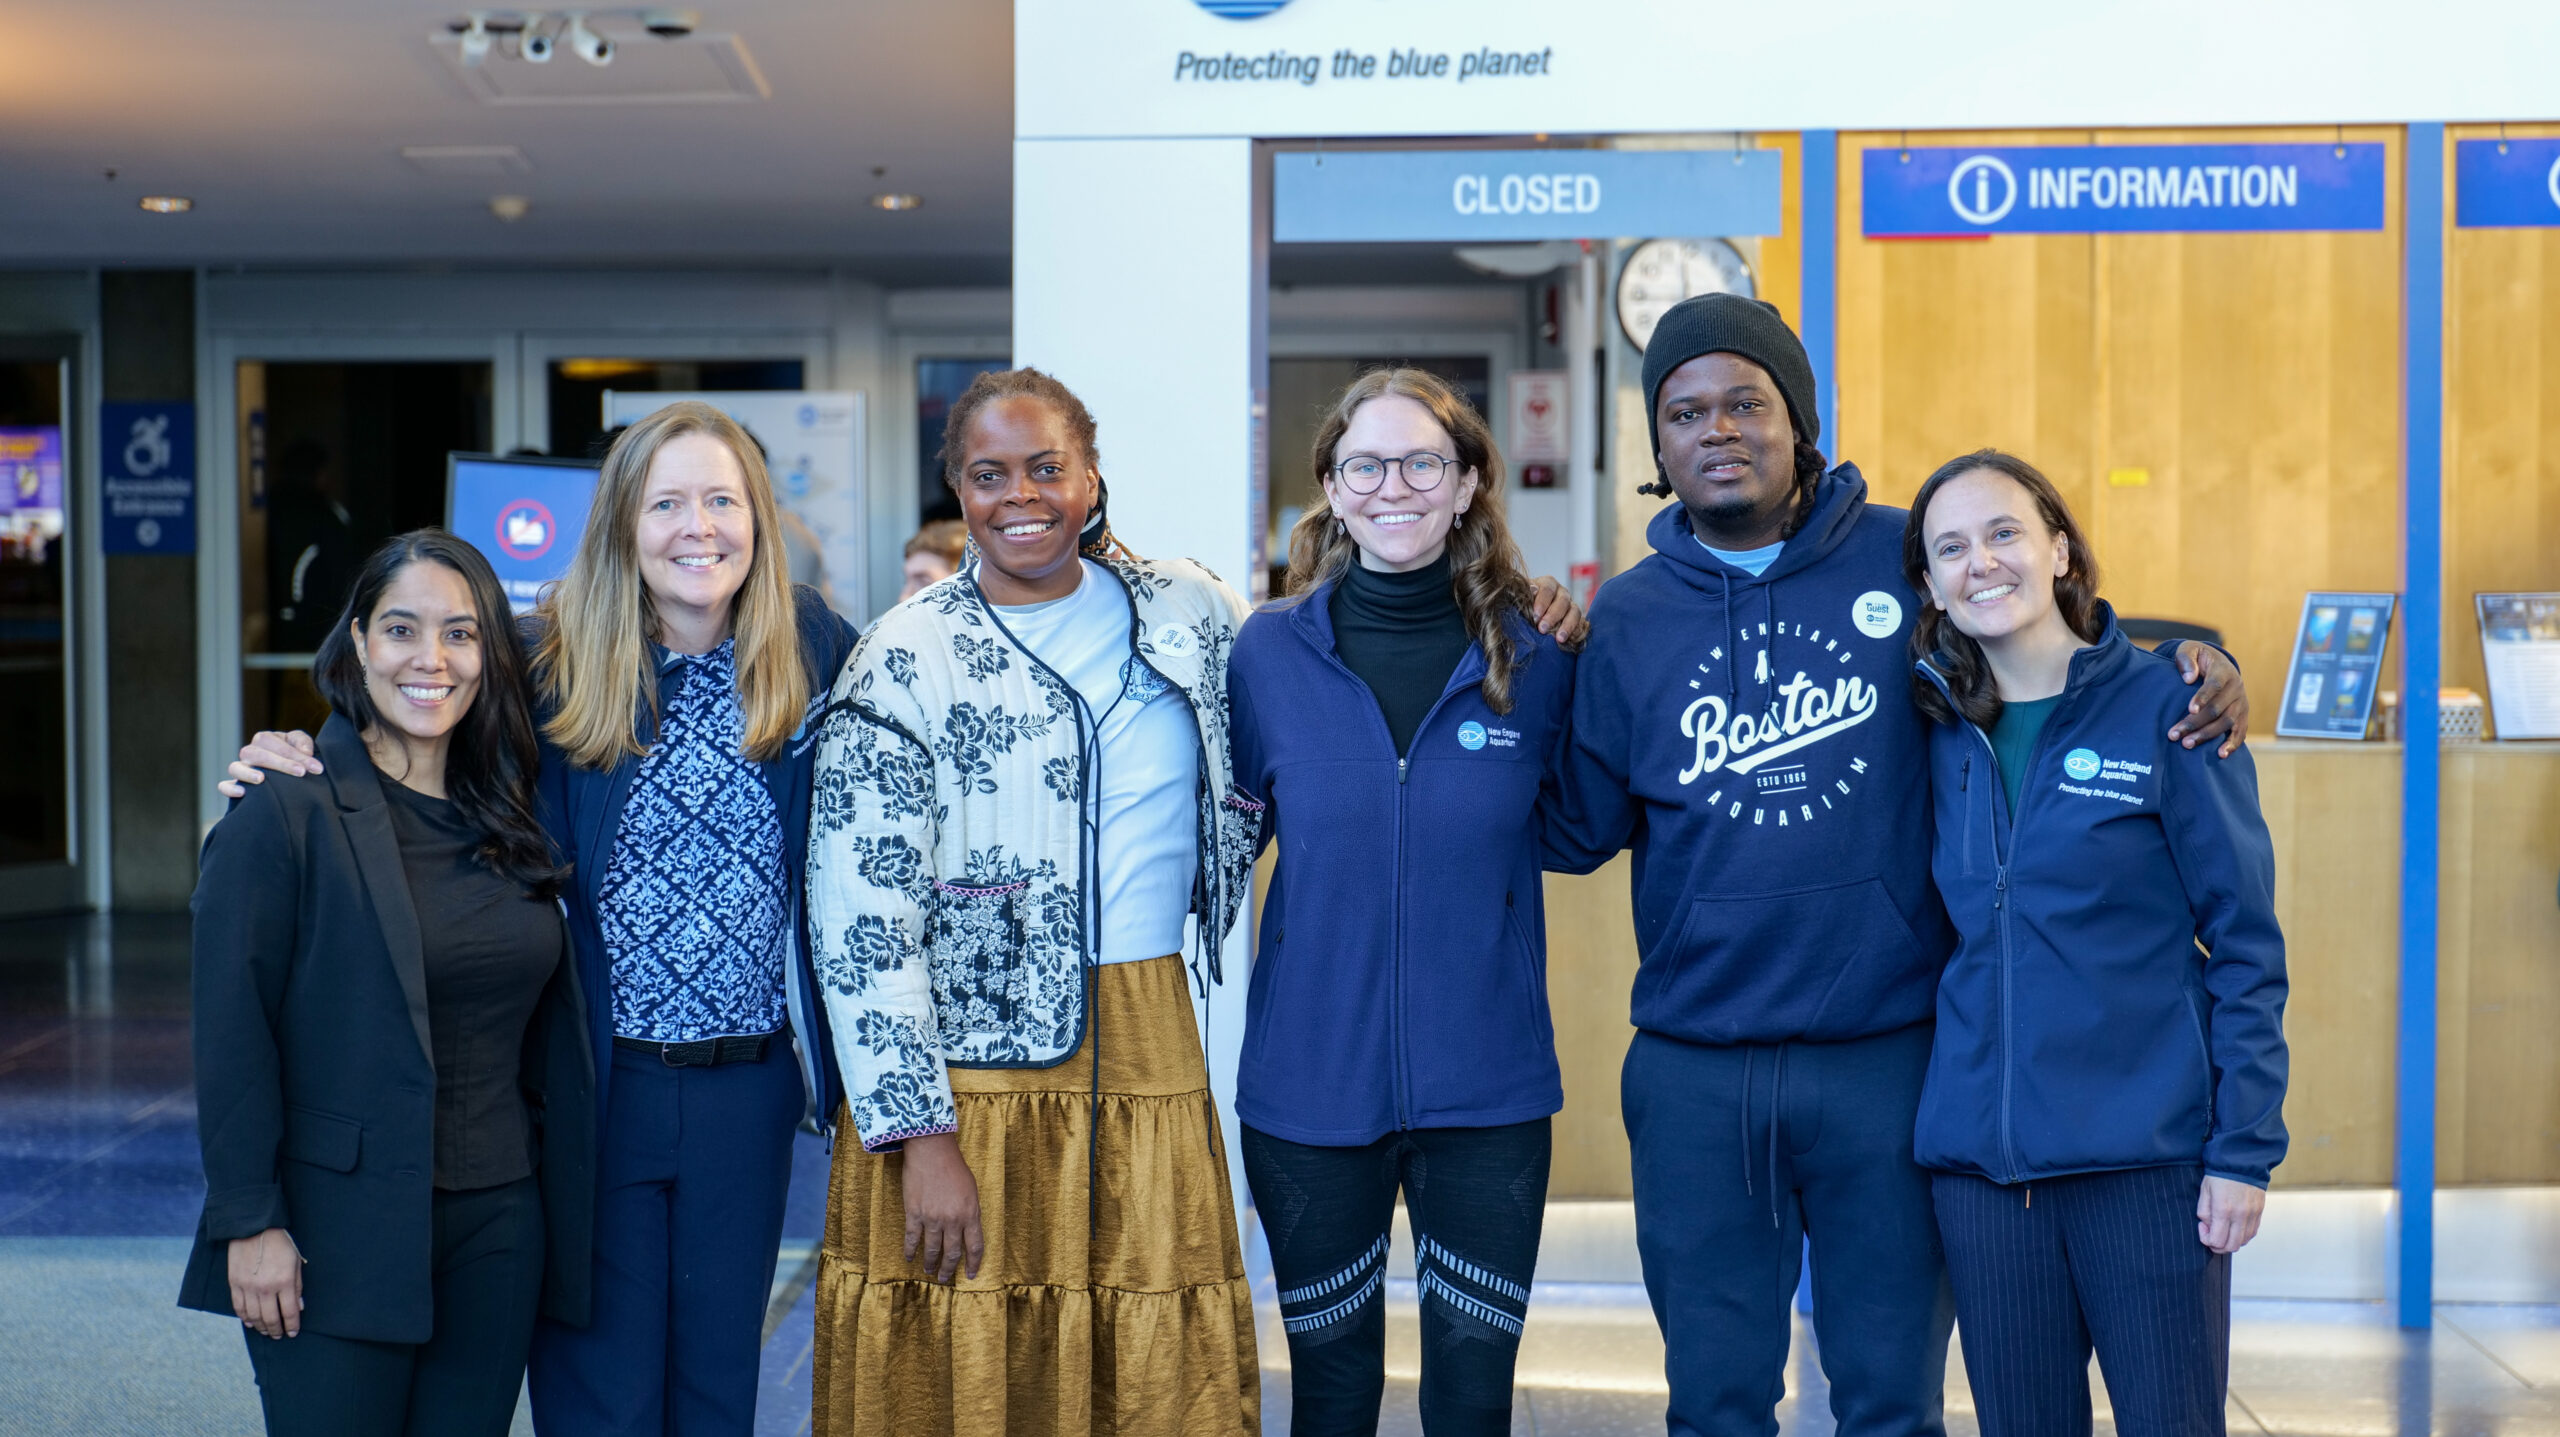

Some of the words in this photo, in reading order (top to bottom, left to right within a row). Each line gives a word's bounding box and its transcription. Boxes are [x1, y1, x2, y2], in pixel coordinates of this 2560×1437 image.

[1174, 50, 1321, 86] Protecting
[1332, 48, 1377, 78] the
[1386, 47, 1450, 78] blue
[1457, 45, 1553, 84] planet
[1452, 173, 1601, 215] CLOSED
[2028, 165, 2298, 209] INFORMATION
[1689, 646, 1723, 690] NEW
[1740, 621, 1852, 664] ENGLAND
[1487, 728, 1501, 736] New
[1489, 737, 1515, 747] Aquarium
[1678, 671, 1878, 785] Boston
[1784, 771, 1806, 783] 1969
[2100, 770, 2137, 782] Aquarium
[2103, 759, 2119, 769] New
[2120, 760, 2152, 775] England
[1707, 756, 1868, 827] AQUARIUM
[2058, 783, 2093, 797] Protecting
[2093, 788, 2105, 798] the
[2104, 789, 2120, 800] blue
[2119, 793, 2144, 806] planet
